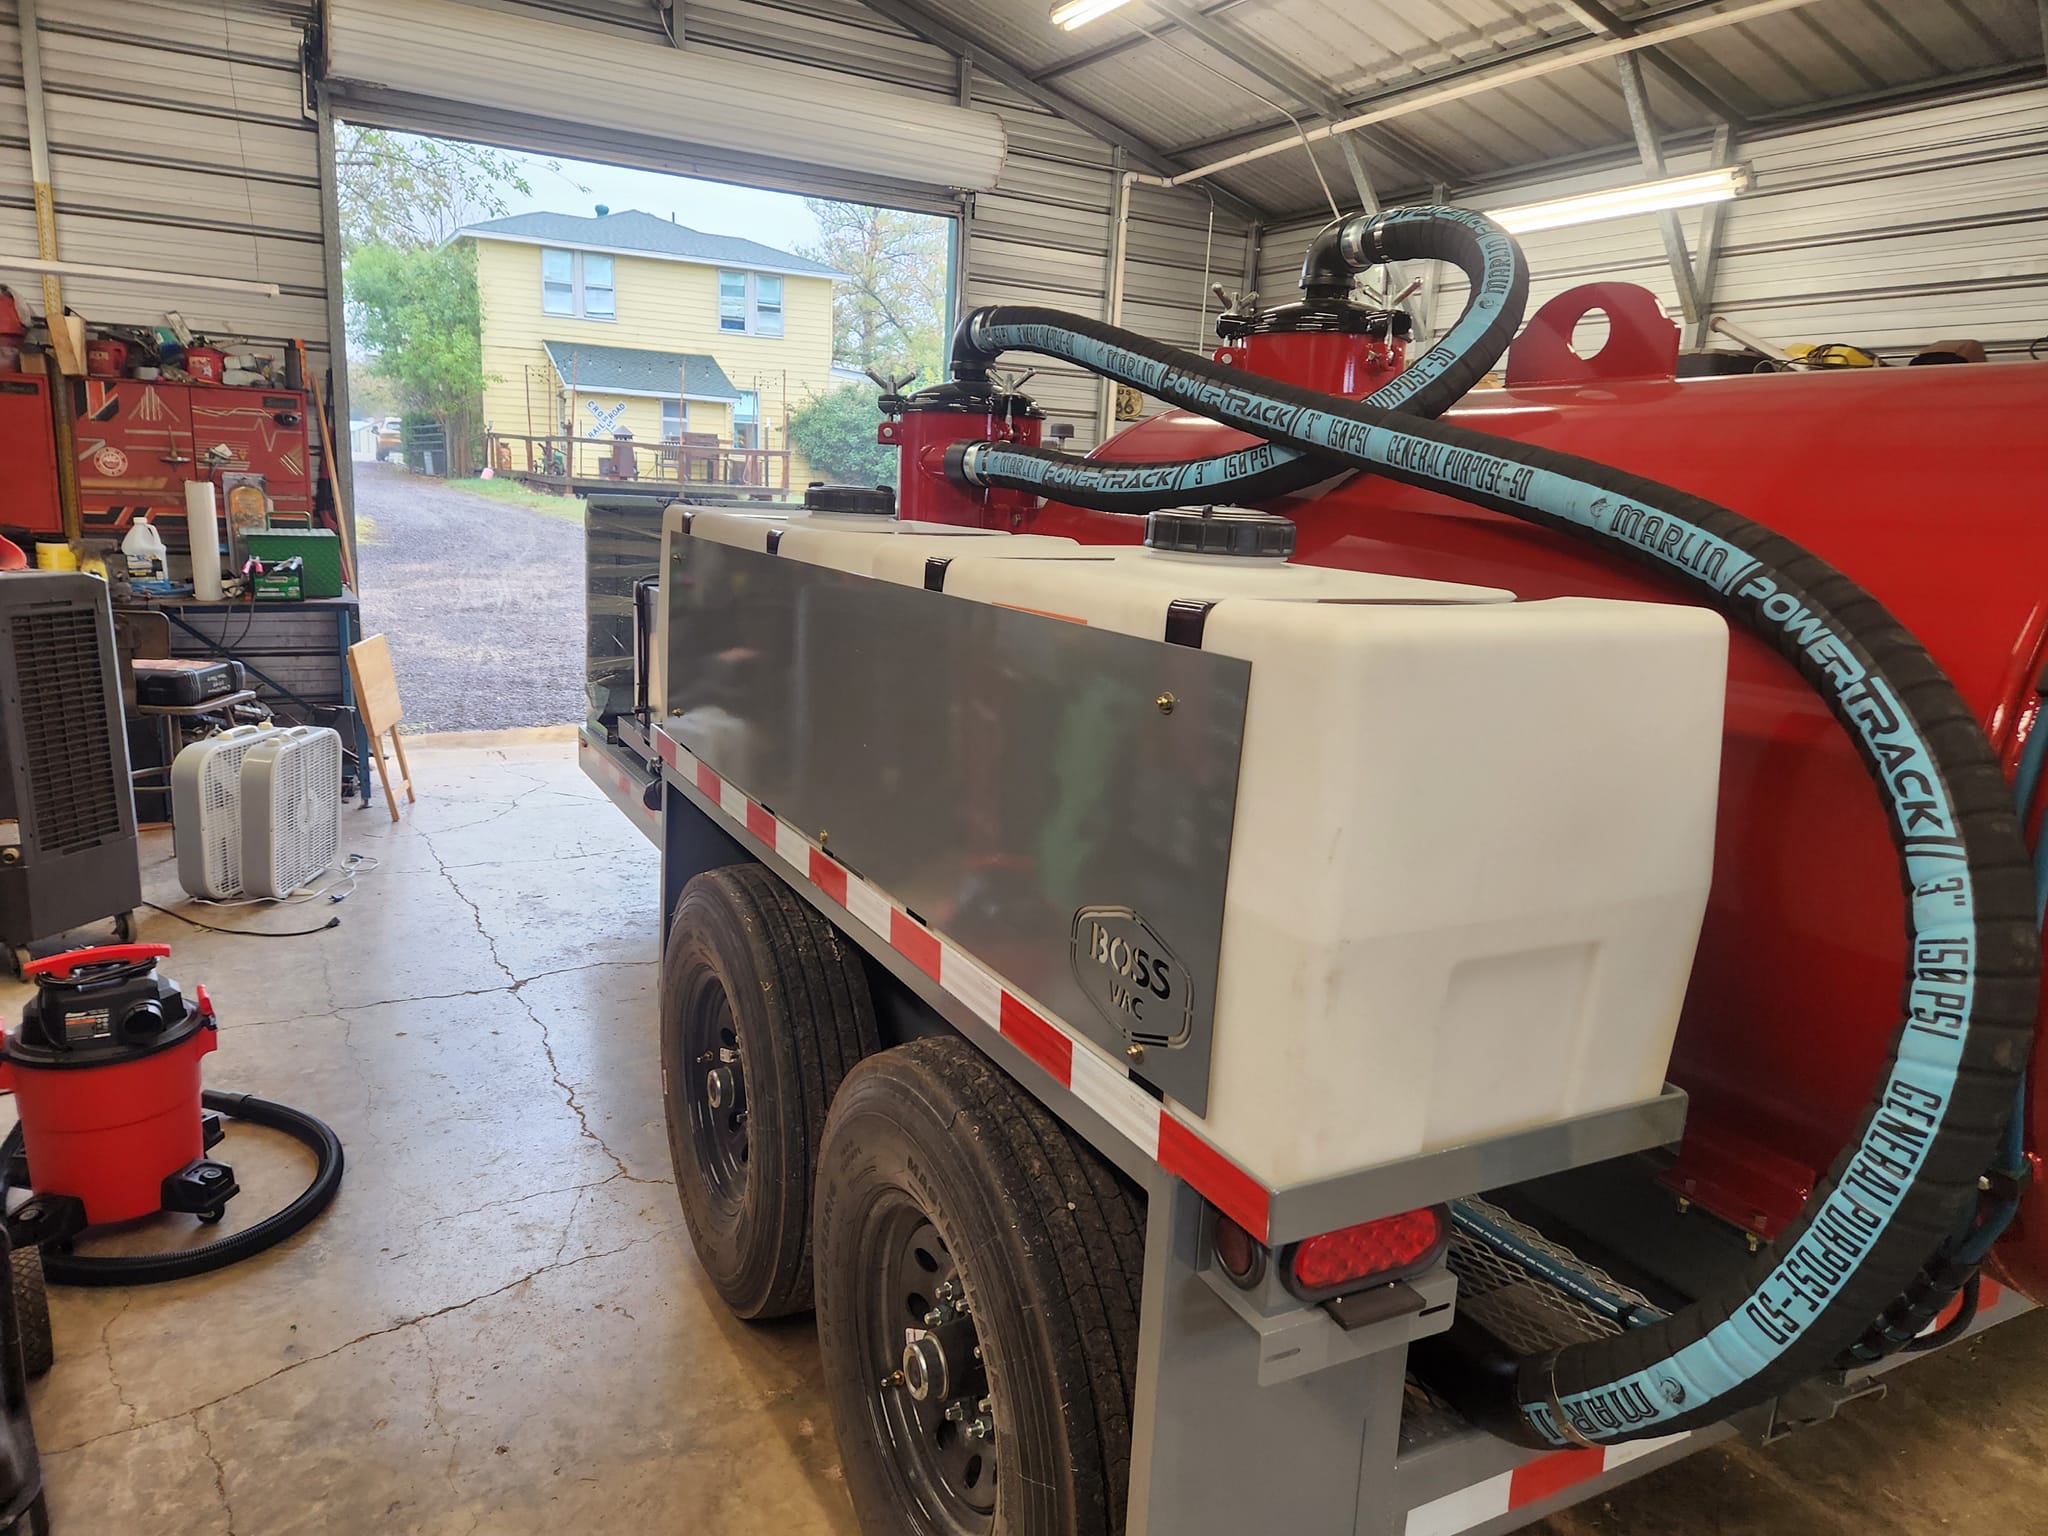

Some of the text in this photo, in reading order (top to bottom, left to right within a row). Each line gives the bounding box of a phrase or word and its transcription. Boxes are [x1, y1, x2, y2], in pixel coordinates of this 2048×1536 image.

[1106, 349, 1155, 386] MARLIN
[1164, 372, 1292, 428] POWERTRACK
[1386, 434, 1443, 477] GENERAL
[1000, 456, 1039, 478] MARLIN
[1045, 466, 1171, 490] POWERTRACK
[1610, 503, 1730, 583] MARLIN
[1737, 575, 1945, 833] POWERTRACK
[1846, 1078, 1943, 1207] GENERAL
[1089, 921, 1171, 1000] BOSS
[1109, 979, 1144, 1021] VAC
